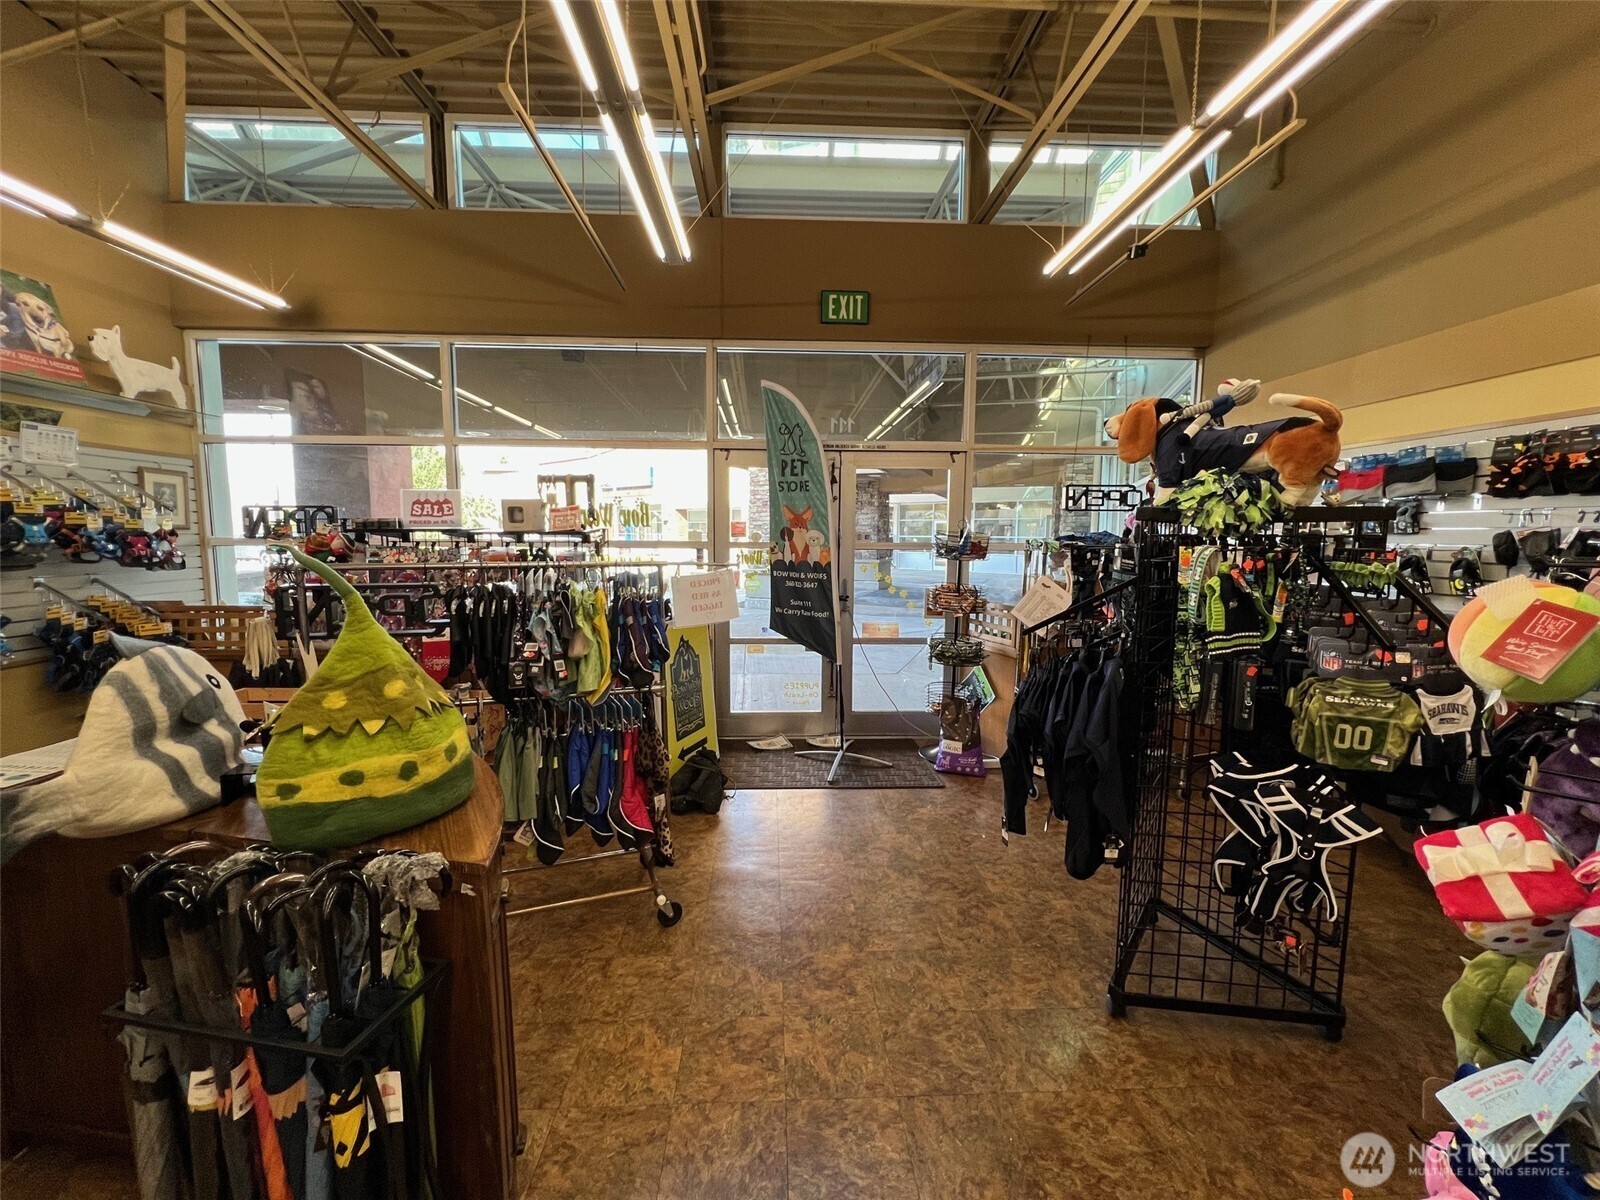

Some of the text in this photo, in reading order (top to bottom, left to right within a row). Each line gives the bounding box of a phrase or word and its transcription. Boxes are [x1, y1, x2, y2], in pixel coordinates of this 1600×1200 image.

[828, 294, 863, 320] EXIT
[780, 459, 809, 477] PET
[778, 480, 810, 492] STORE
[412, 503, 453, 517] SALE
[783, 608, 801, 616] Carry
[811, 610, 830, 618] Food!
[1325, 695, 1396, 709] SEAHAWKS
[1333, 723, 1374, 751] 00
